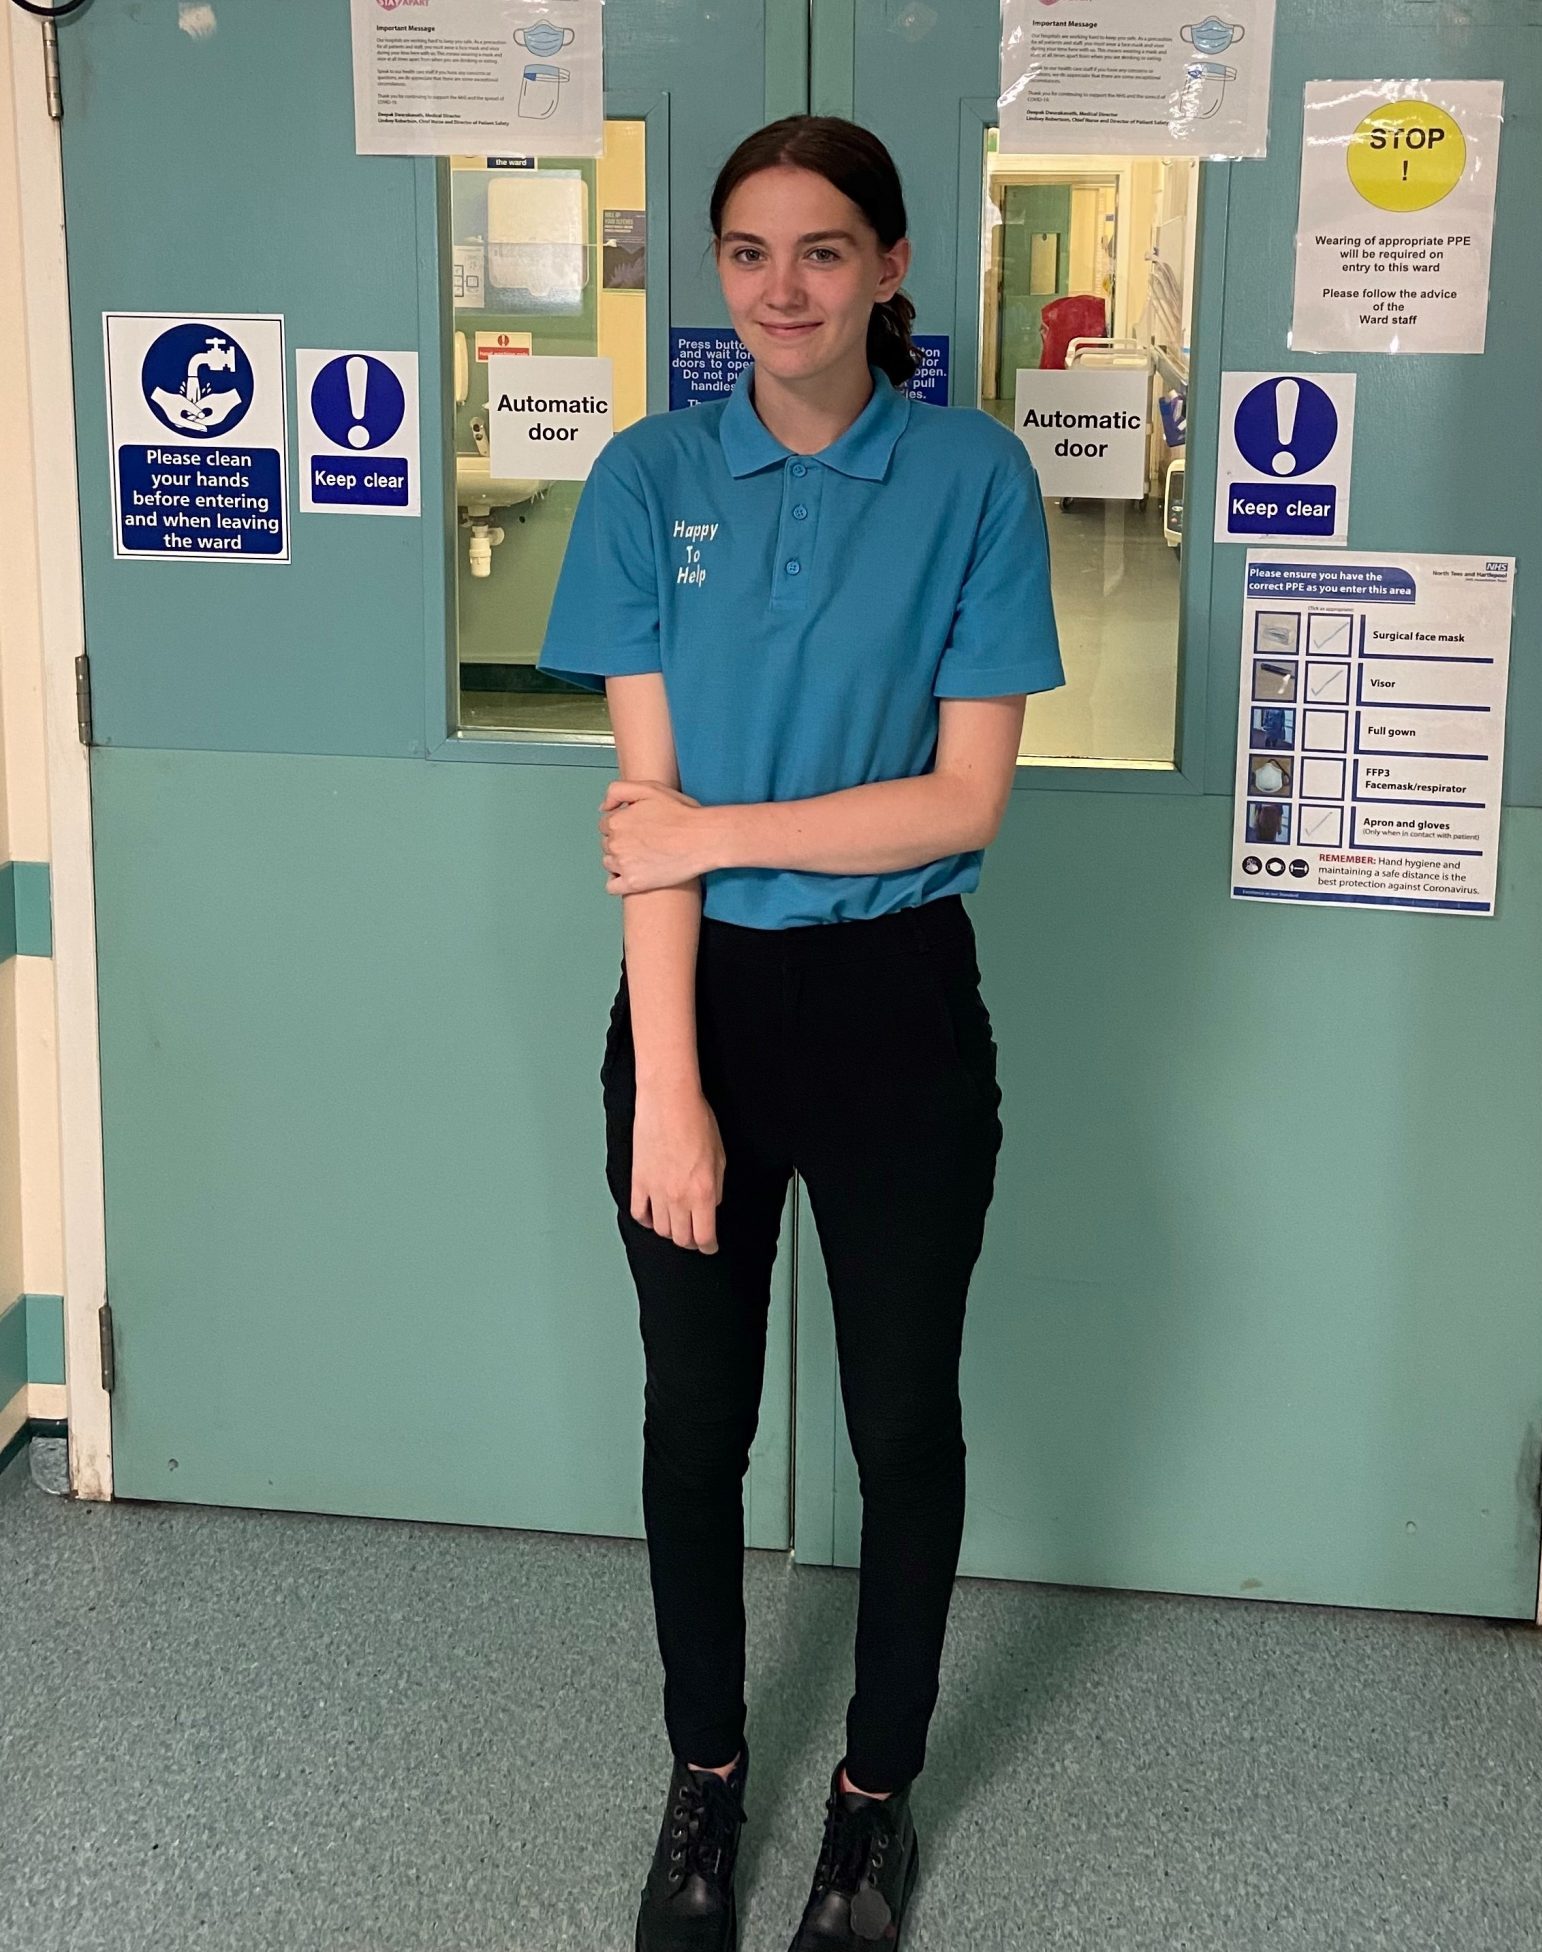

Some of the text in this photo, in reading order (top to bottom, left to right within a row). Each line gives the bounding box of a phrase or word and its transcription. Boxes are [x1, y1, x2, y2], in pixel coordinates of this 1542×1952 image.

[408, 25, 435, 33] Message
[1068, 21, 1098, 29] Message
[1370, 128, 1445, 149] STOP
[1315, 236, 1471, 248] Wearing of appropriate PPE
[1340, 249, 1444, 261] will be required on
[1342, 262, 1440, 274] entry to this ward
[1323, 288, 1457, 299] Please follow the advice
[1373, 302, 1405, 312] of the
[1360, 315, 1418, 325] Ward staff
[678, 339, 746, 350] Press butto
[680, 349, 752, 360] and wait for
[672, 358, 706, 368] doors
[711, 359, 722, 369] to
[683, 369, 699, 379] Do
[703, 370, 723, 380] not
[913, 377, 935, 390] pull
[497, 394, 608, 414] Automatic
[1023, 409, 1141, 429] Automatic
[529, 423, 579, 441] door
[1055, 438, 1108, 458] door
[147, 449, 252, 467] Please clean
[152, 471, 249, 489] your hands
[315, 470, 404, 490] Keep clear
[133, 490, 269, 513] before entering
[1233, 499, 1331, 519] Keep clear
[125, 512, 279, 534] and when leaving
[673, 520, 719, 543] Happy
[163, 533, 242, 550] the ward
[686, 545, 700, 563] To
[1486, 562, 1508, 572] NHS
[677, 564, 706, 587] Help
[1250, 568, 1383, 581] Please ensure you have the
[1249, 582, 1284, 591] correct
[1286, 582, 1304, 592] PPE
[1319, 585, 1338, 594] you
[1340, 585, 1367, 594] enter
[1368, 585, 1387, 594] this
[1373, 630, 1465, 642] Surgical face mask
[1371, 679, 1396, 688] Visor
[1368, 726, 1416, 738] Full gown
[1366, 768, 1390, 777] FFP3
[1365, 780, 1467, 794] Facemask/respirator
[1363, 817, 1450, 831] Apron and gloves
[1319, 853, 1461, 869] REMEMBER: Hand hygiene and
[1318, 867, 1372, 879] maintaining
[1382, 869, 1400, 878] safe
[1402, 870, 1440, 881] distance
[1442, 873, 1449, 881] is
[1451, 873, 1467, 882] the
[1318, 877, 1480, 895] best protection against Coronavirus.
